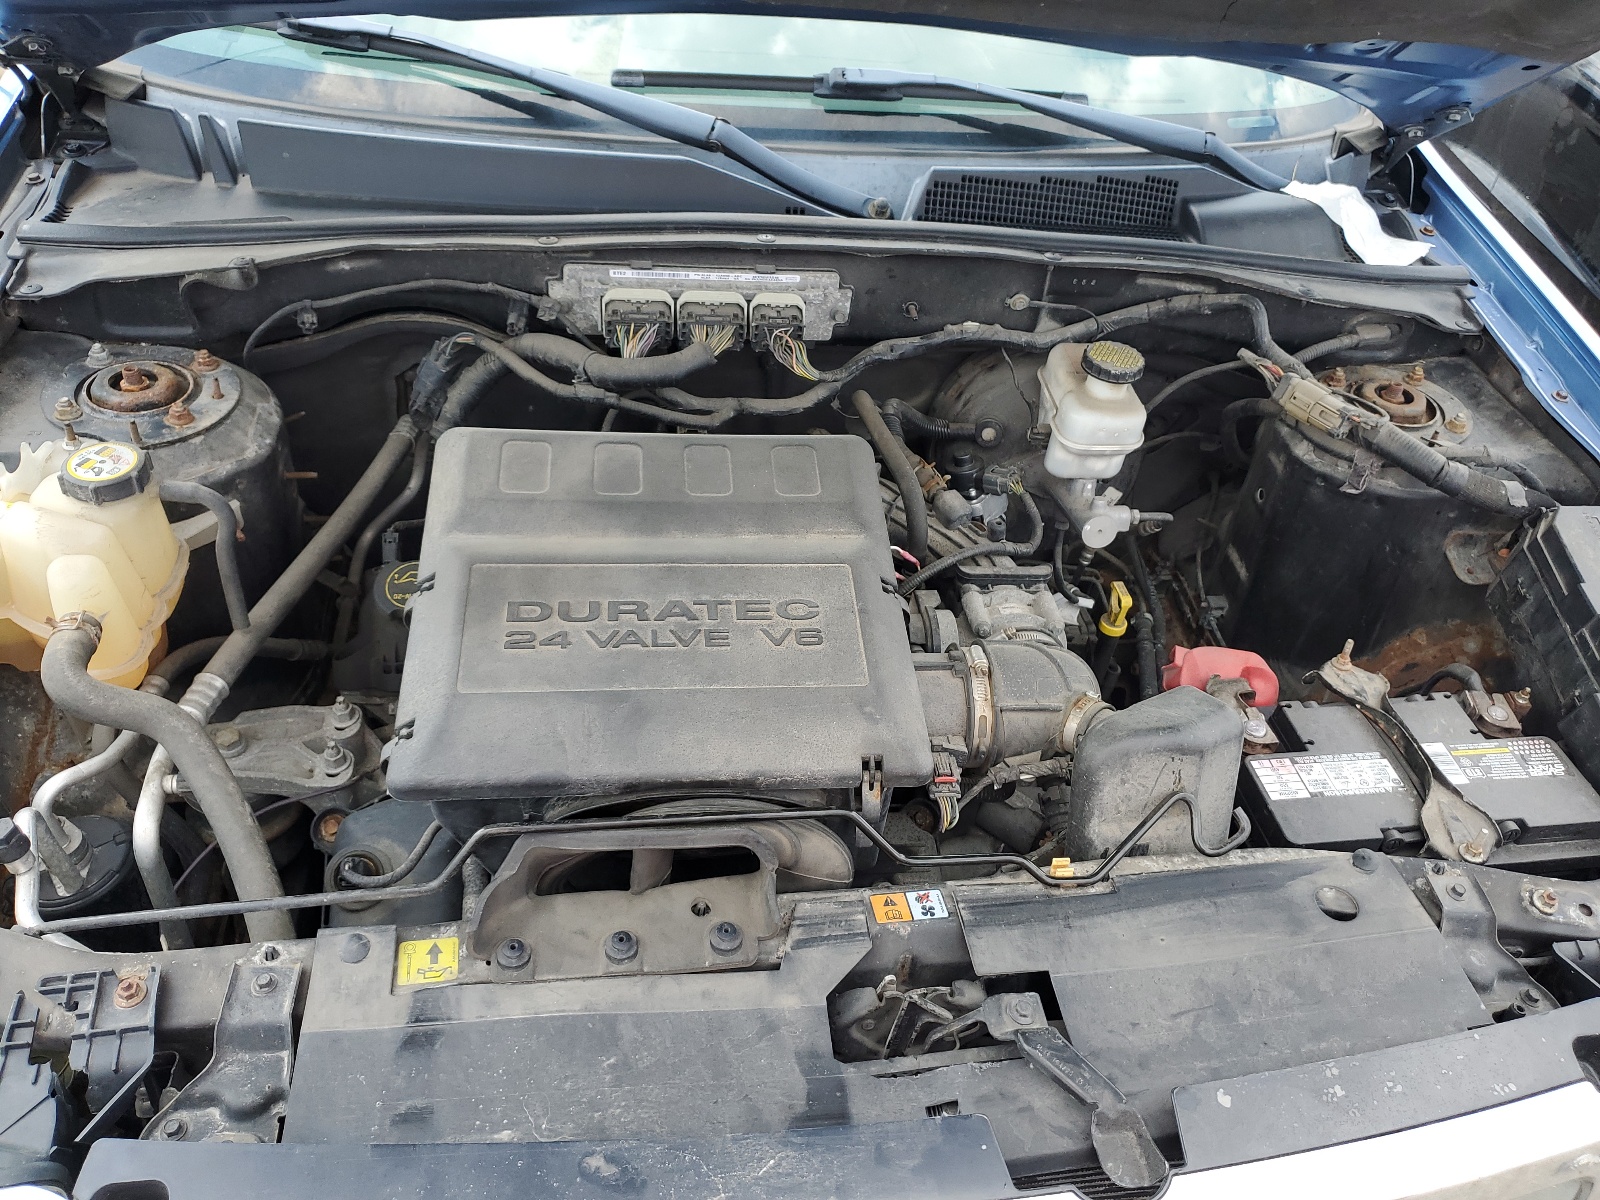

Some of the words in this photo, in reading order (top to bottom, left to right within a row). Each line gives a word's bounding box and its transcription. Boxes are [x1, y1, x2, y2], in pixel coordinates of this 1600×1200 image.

[505, 599, 820, 623] DURATEC
[503, 630, 573, 650] 24
[586, 628, 731, 649] VALVE
[760, 627, 824, 647] V6
